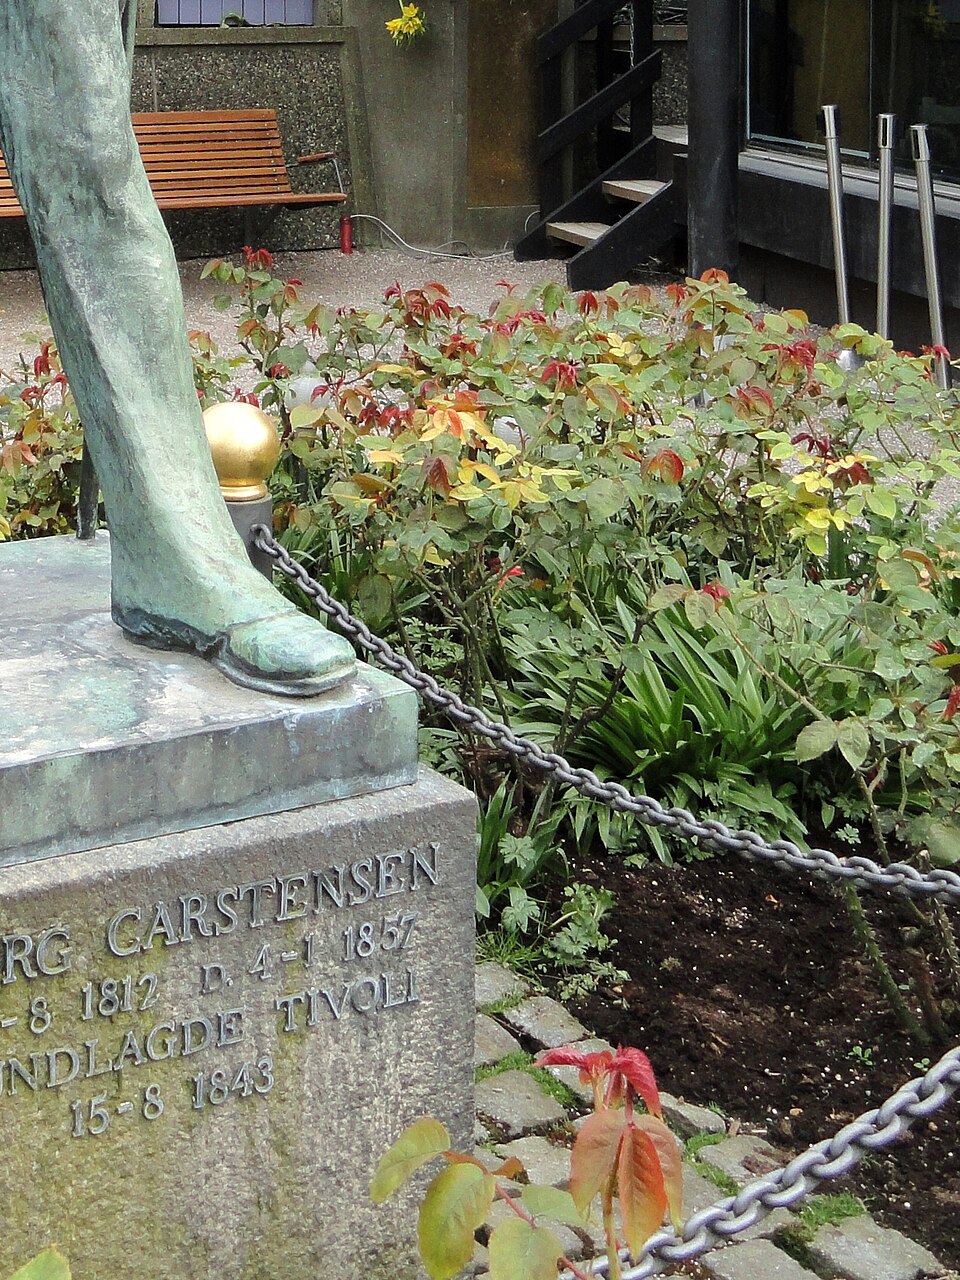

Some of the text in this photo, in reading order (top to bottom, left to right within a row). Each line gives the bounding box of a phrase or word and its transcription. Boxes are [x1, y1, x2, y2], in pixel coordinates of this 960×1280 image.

[108, 842, 440, 956] CARSTENSEN
[81, 972, 160, 1020] 1812
[202, 963, 234, 994] D.
[344, 910, 419, 961] 1857
[275, 966, 420, 1032] TIVOLI
[193, 1055, 275, 1109] 1843
